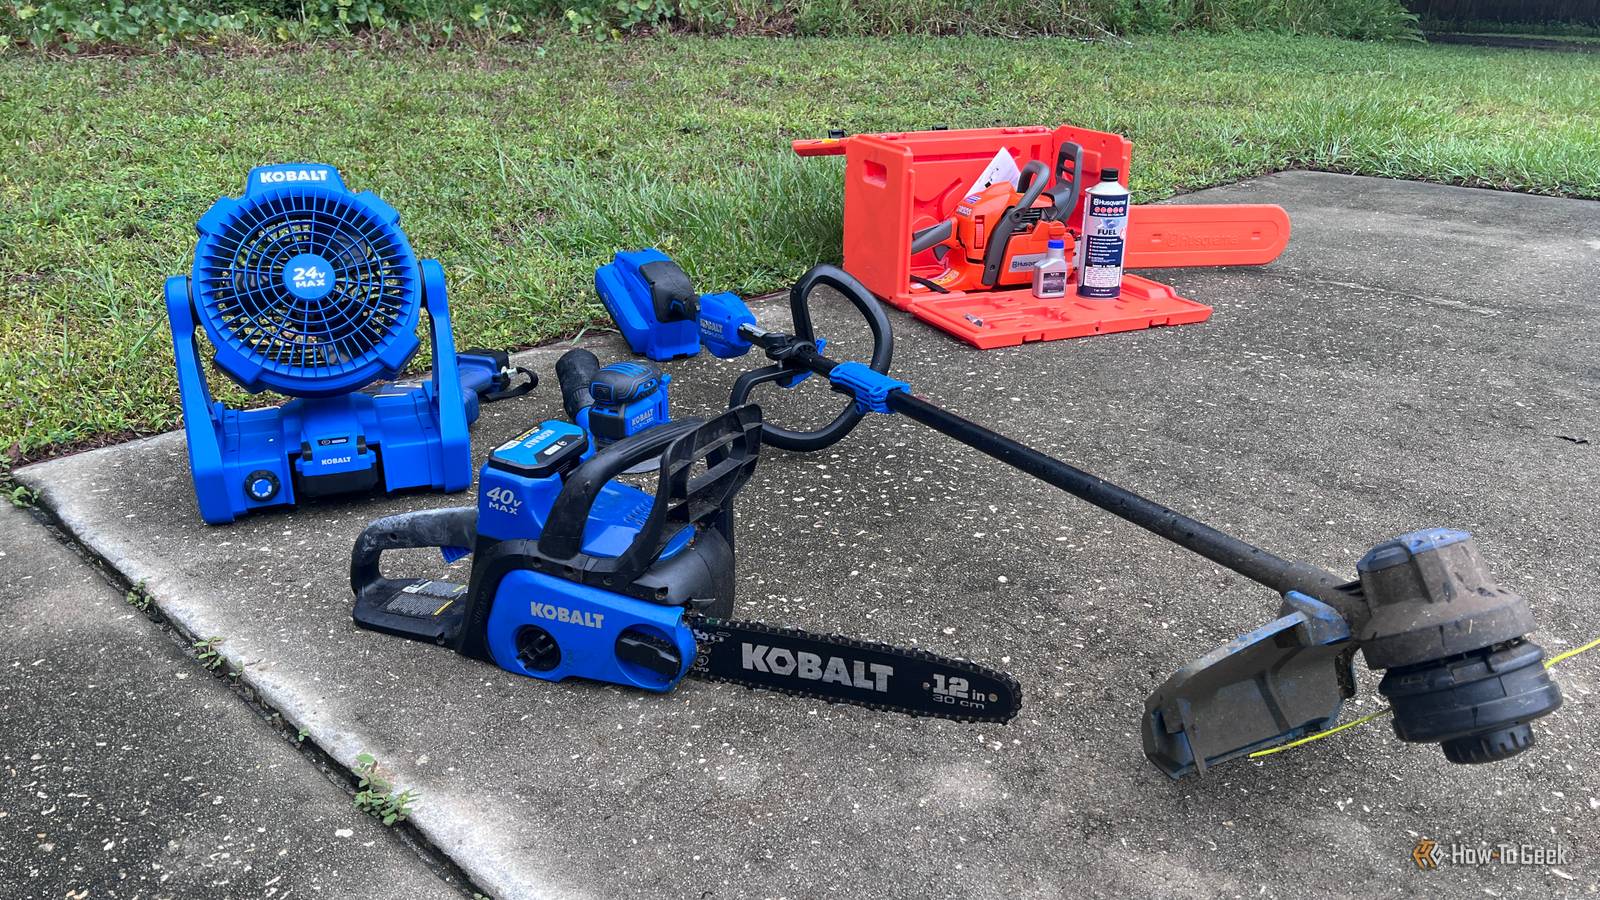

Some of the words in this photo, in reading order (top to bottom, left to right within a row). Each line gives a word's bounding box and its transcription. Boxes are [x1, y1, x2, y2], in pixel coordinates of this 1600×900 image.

[260, 170, 328, 183] KOBALT
[1097, 228, 1117, 236] FUEL
[295, 278, 326, 288] MAX
[631, 408, 654, 427] KOBALT
[321, 457, 352, 465] KOBALT
[488, 501, 518, 515] MAX
[530, 601, 605, 629] KOBALT
[741, 642, 894, 693] KOBALT
[932, 673, 969, 699] 12
[971, 688, 985, 702] in
[932, 693, 955, 705] 30
[960, 700, 985, 710] cm
